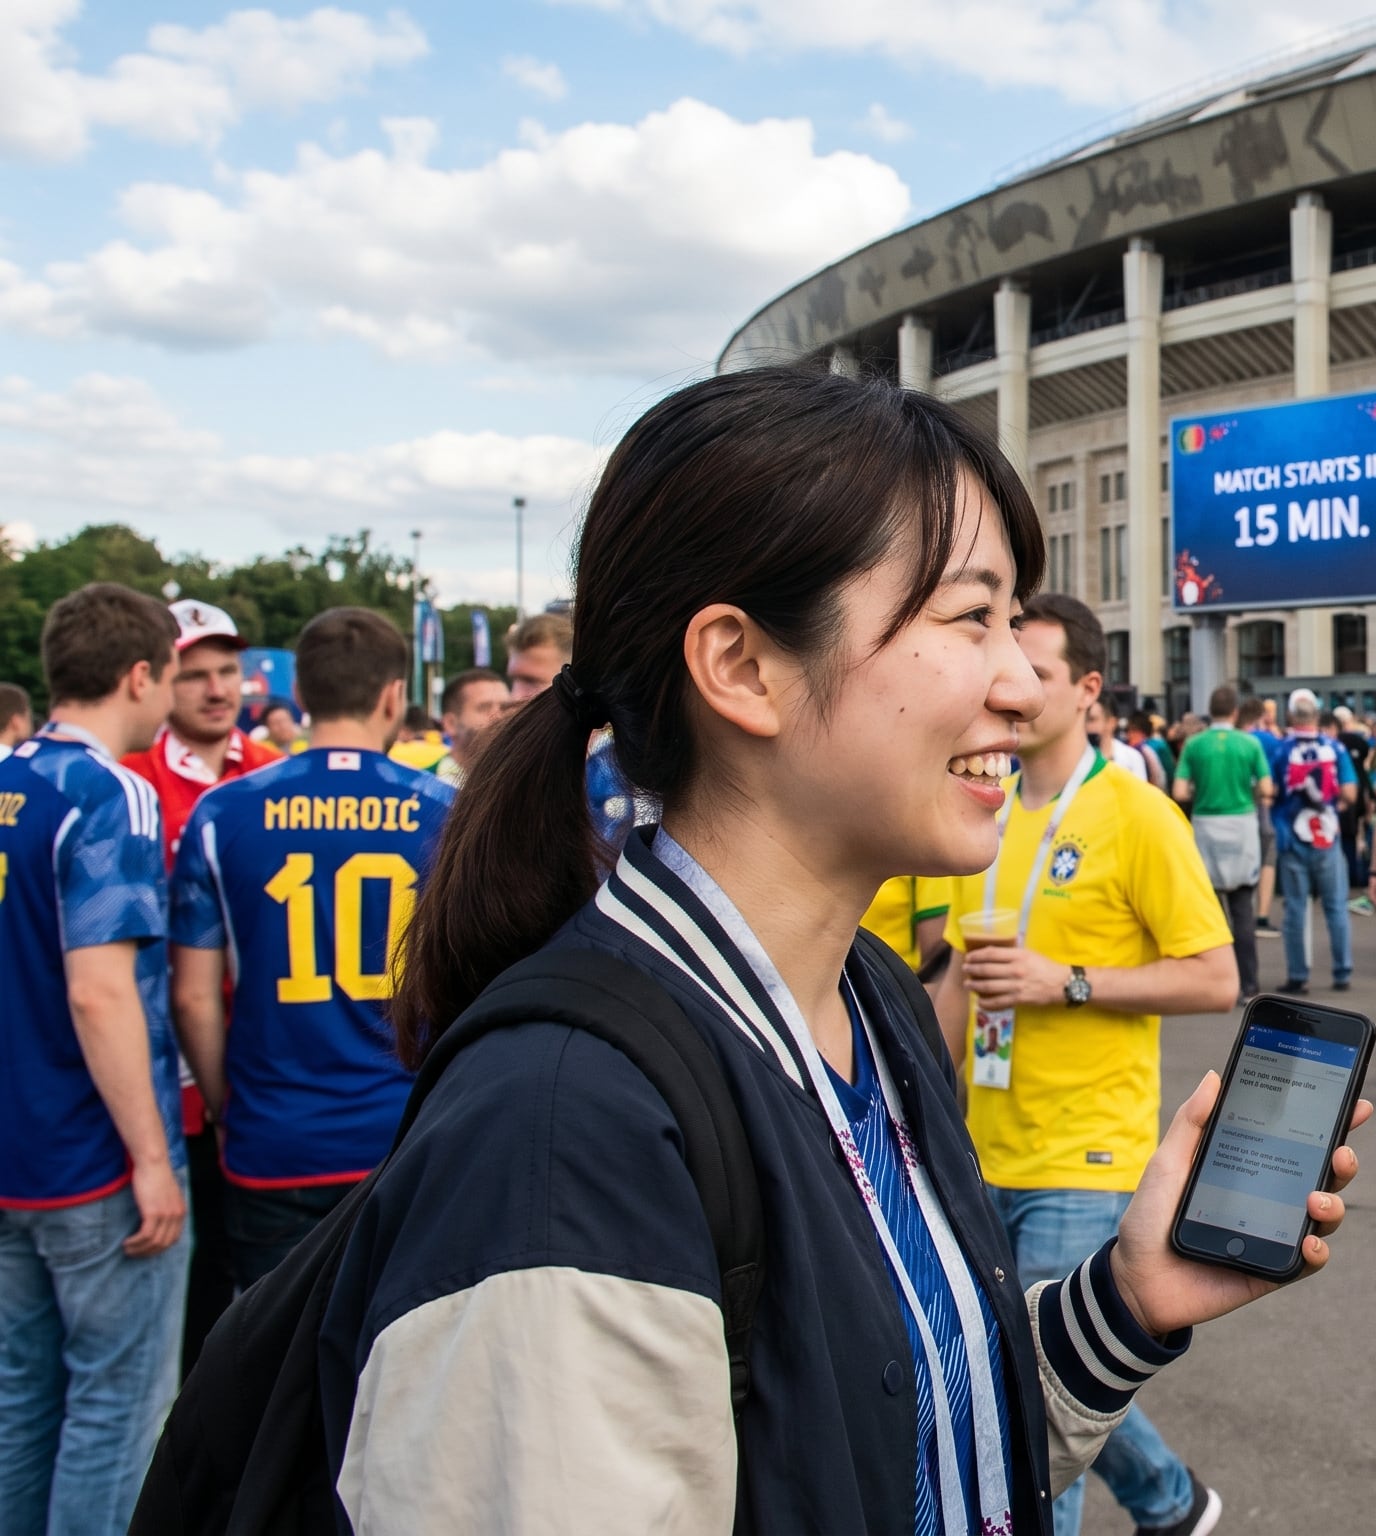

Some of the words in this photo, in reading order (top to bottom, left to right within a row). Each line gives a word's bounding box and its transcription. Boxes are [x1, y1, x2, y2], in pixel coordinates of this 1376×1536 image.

[1214, 465, 1281, 495] MATCH
[1283, 455, 1361, 488] STARTS
[1234, 504, 1279, 548] 15
[1288, 495, 1370, 543] MIN.
[264, 792, 421, 832] MANROIĆ
[264, 852, 419, 1004] 10
